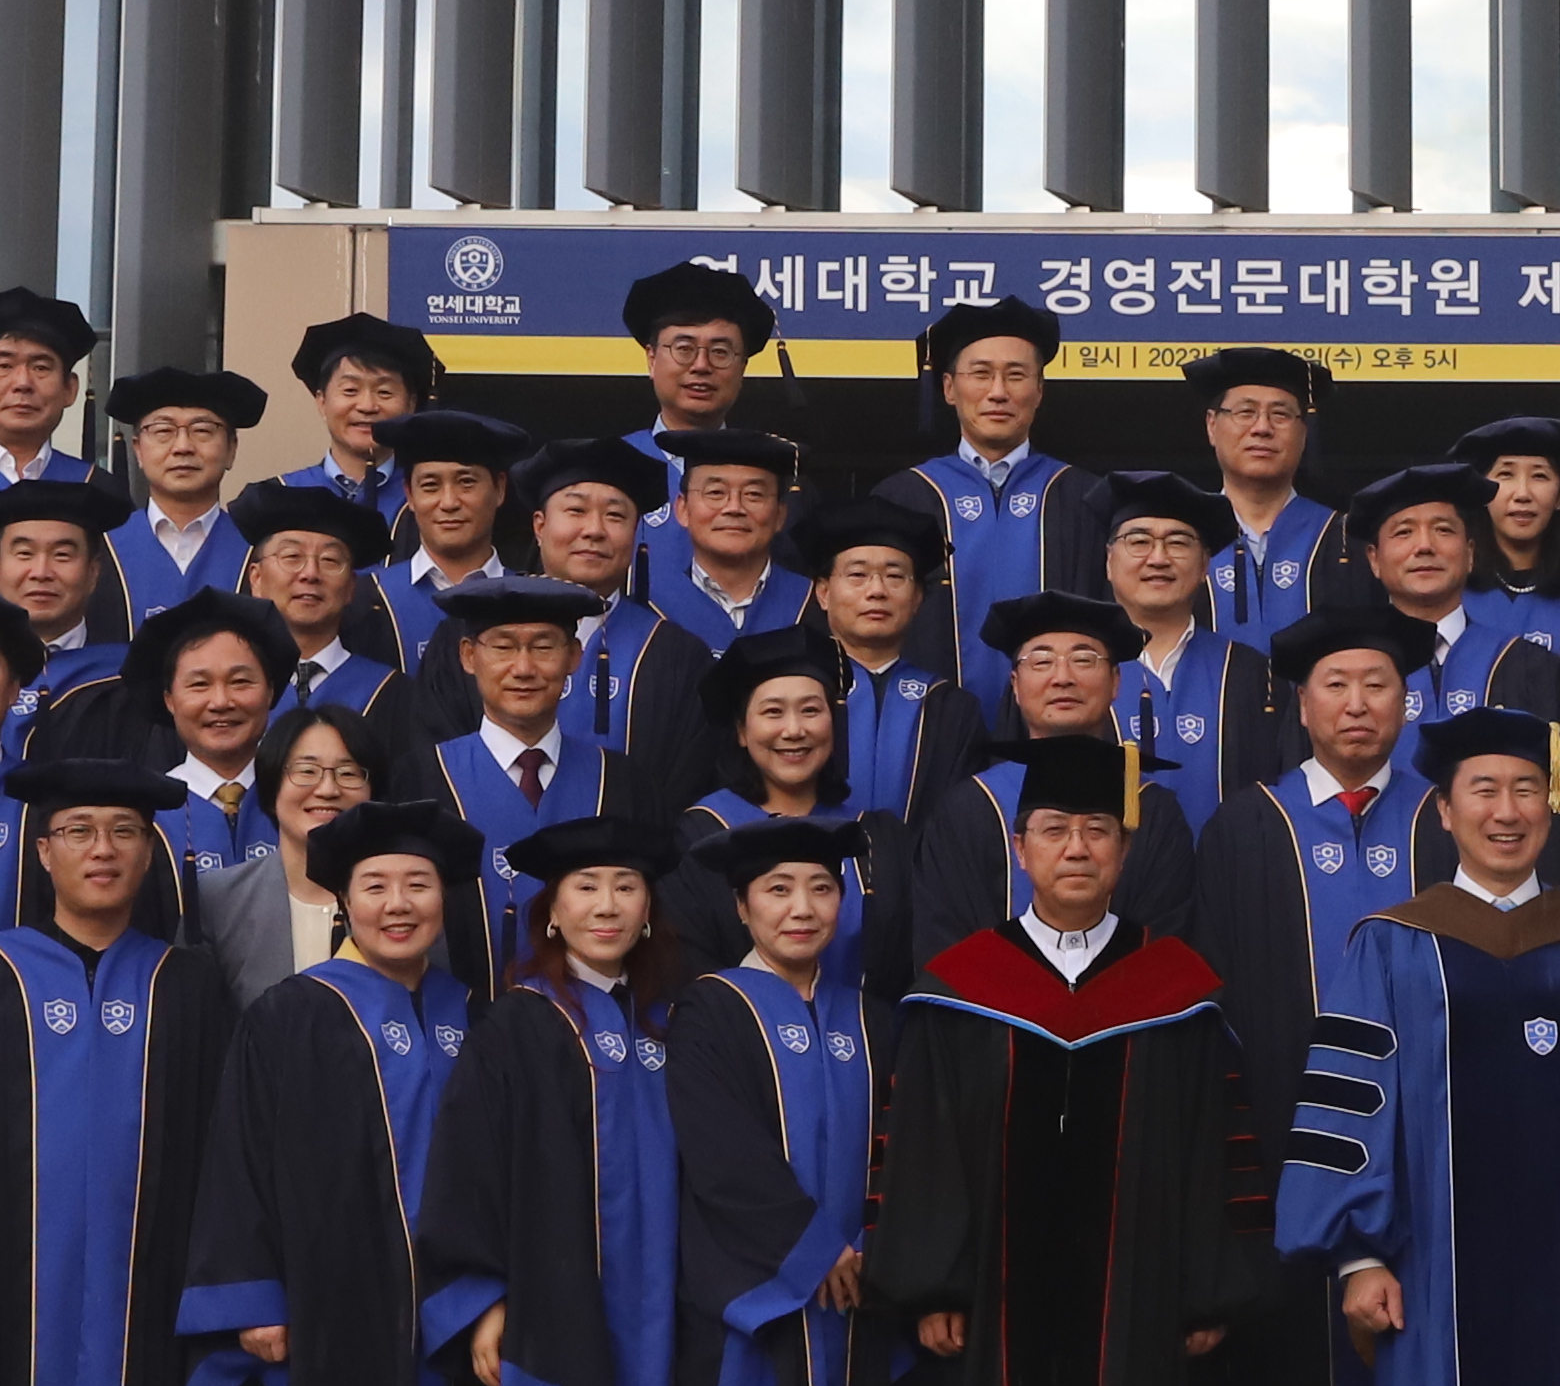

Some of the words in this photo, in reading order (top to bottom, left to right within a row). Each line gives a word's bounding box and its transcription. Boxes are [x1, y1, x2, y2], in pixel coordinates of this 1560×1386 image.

[689, 254, 1001, 312] 세대학교
[1039, 257, 1481, 316] 경영전문대학원
[427, 295, 521, 314] 연세대학교
[429, 315, 463, 324] YONSEI
[465, 315, 520, 324] UNIVERSITY
[1079, 346, 1120, 368] 일시
[1371, 348, 1414, 369] 오후
[1423, 348, 1457, 370] 5시
